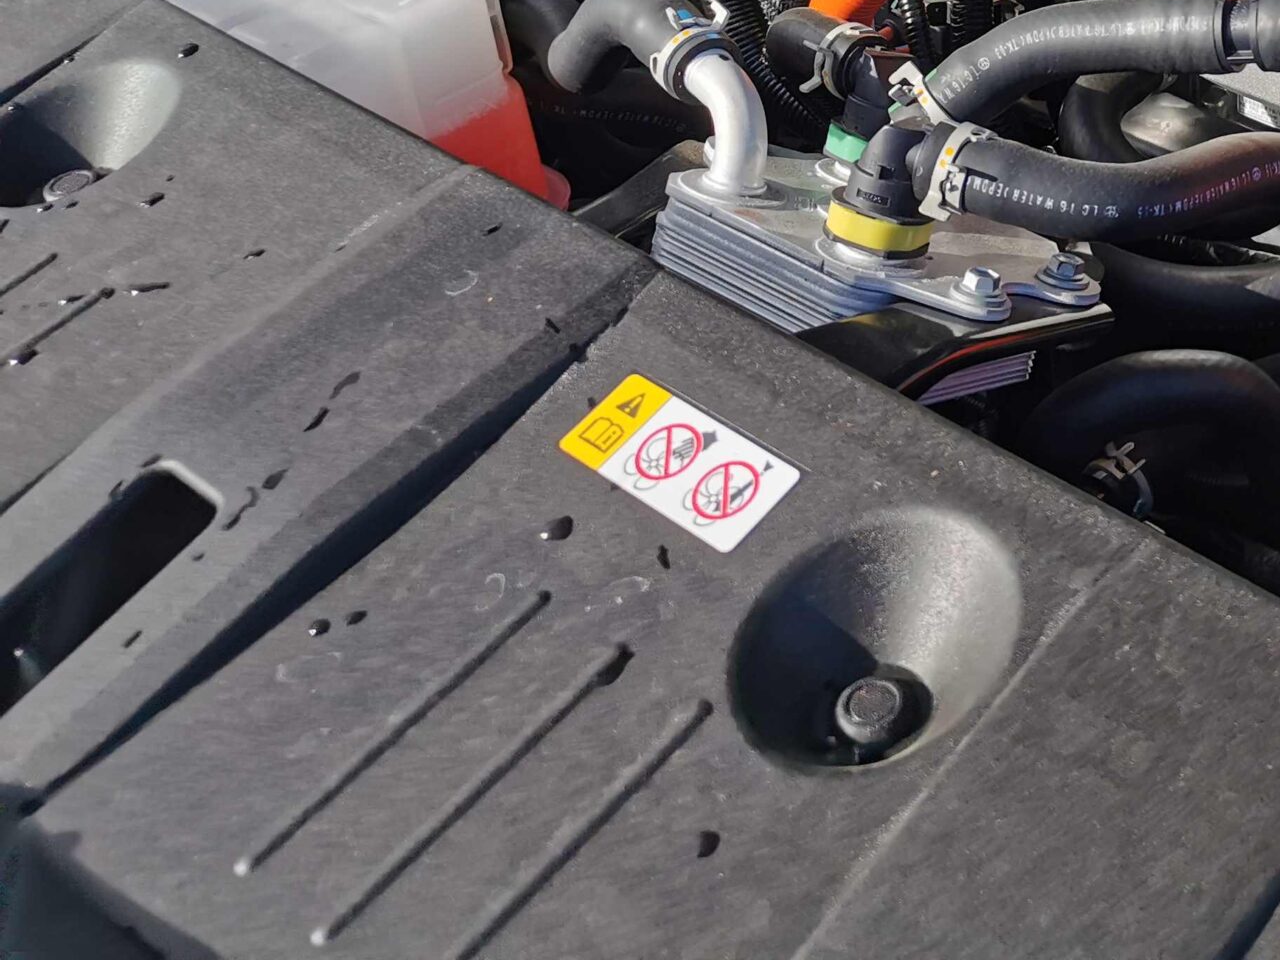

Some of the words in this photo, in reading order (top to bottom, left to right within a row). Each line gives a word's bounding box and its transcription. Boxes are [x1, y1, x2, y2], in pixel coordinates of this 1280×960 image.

[1012, 187, 1054, 210] WATER
[1059, 201, 1076, 215] 16
[1080, 203, 1099, 217] LC
